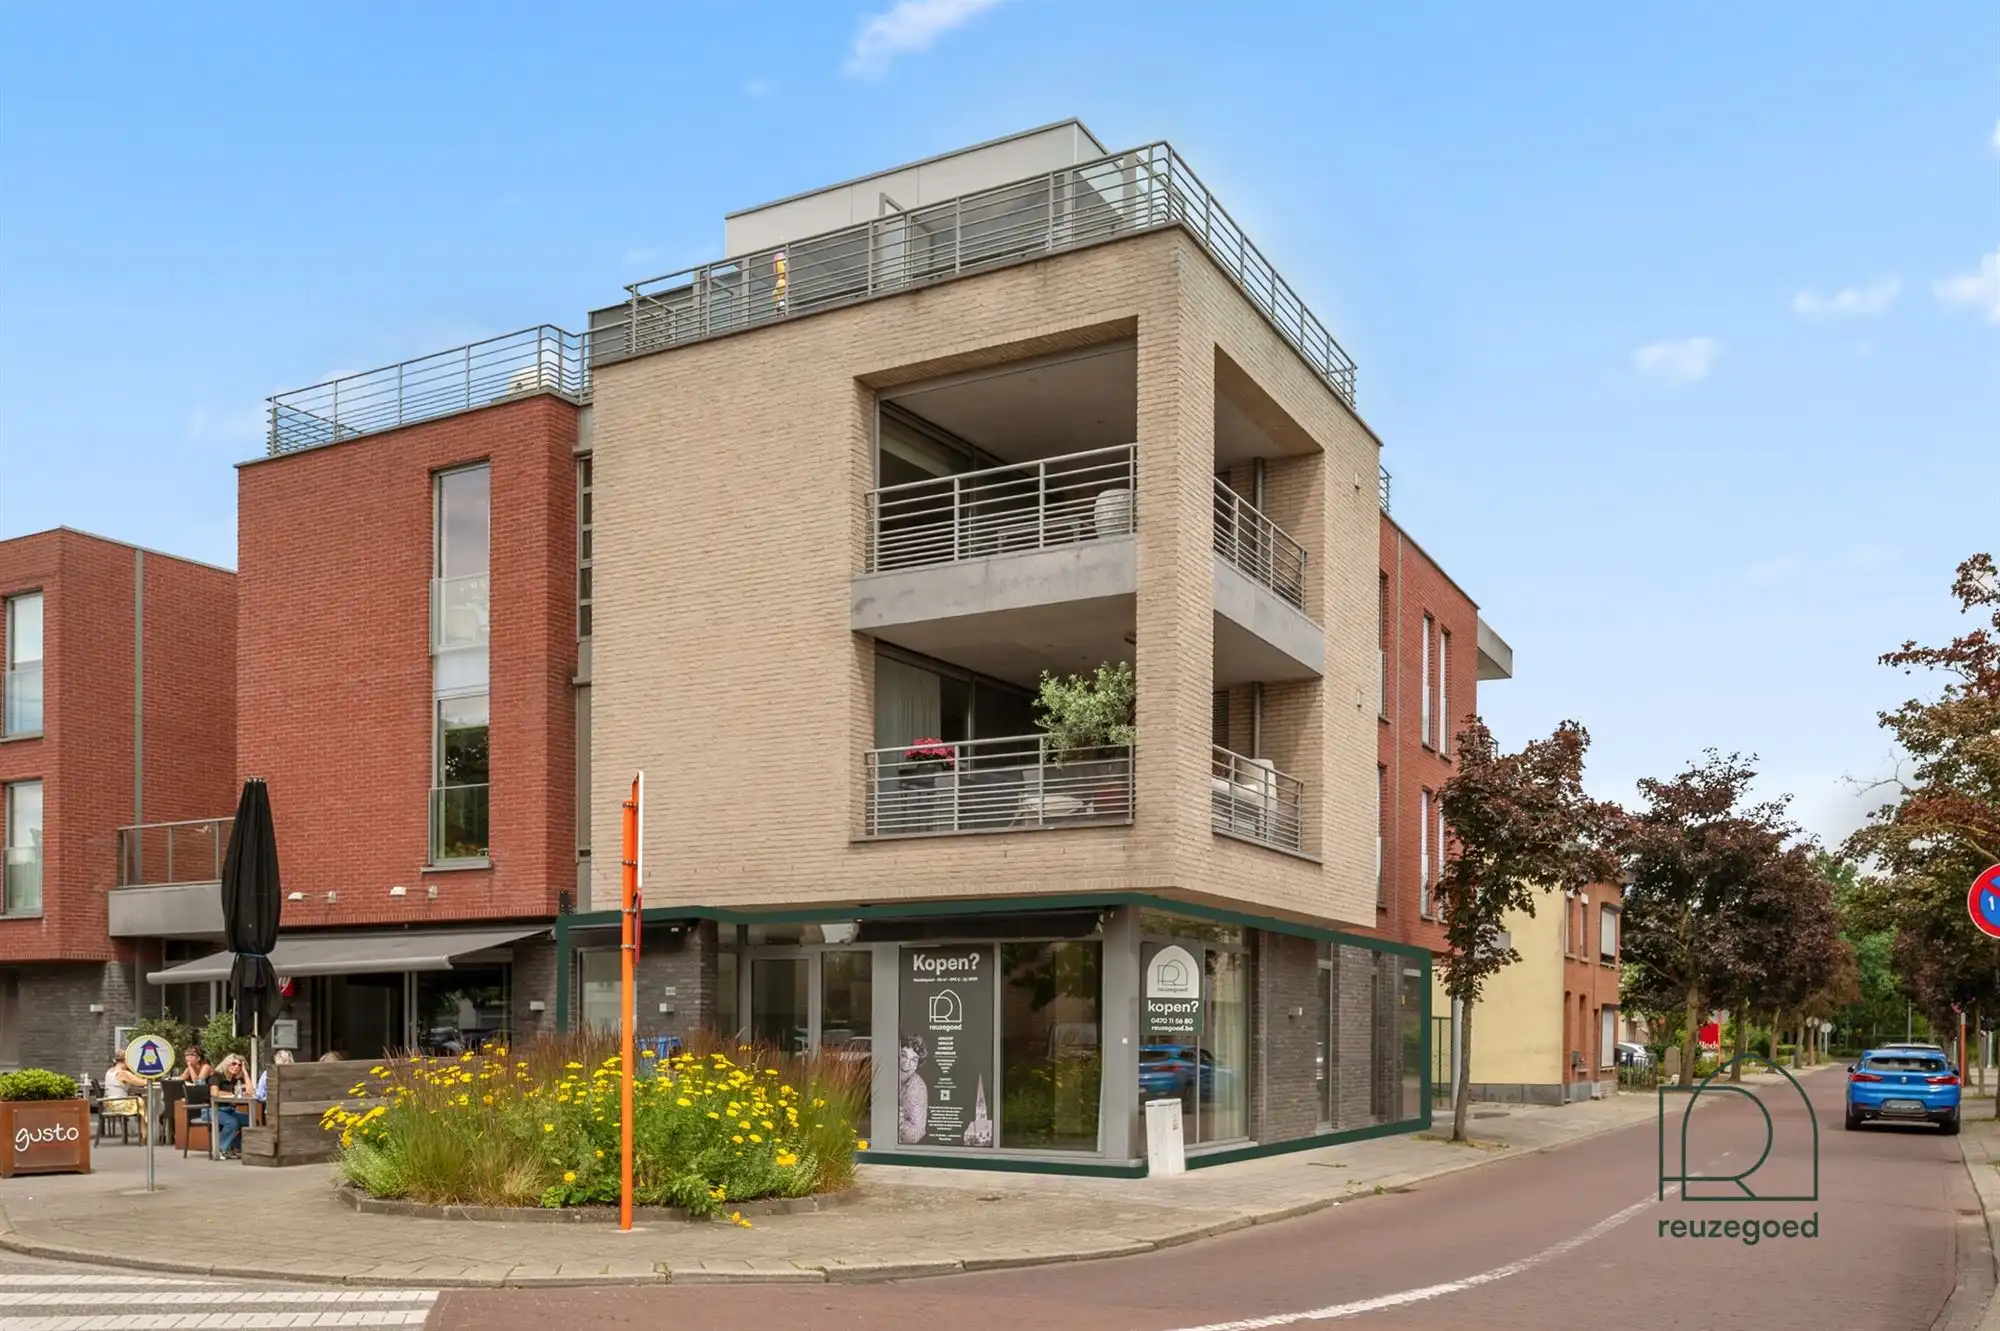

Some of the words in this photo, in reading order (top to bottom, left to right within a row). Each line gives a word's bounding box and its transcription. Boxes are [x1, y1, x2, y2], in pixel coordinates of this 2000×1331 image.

[913, 953, 980, 975] Kopen?
[1148, 1000, 1199, 1015] kopen?
[929, 1024, 962, 1032] reuzegoed
[14, 1123, 79, 1152] gusto
